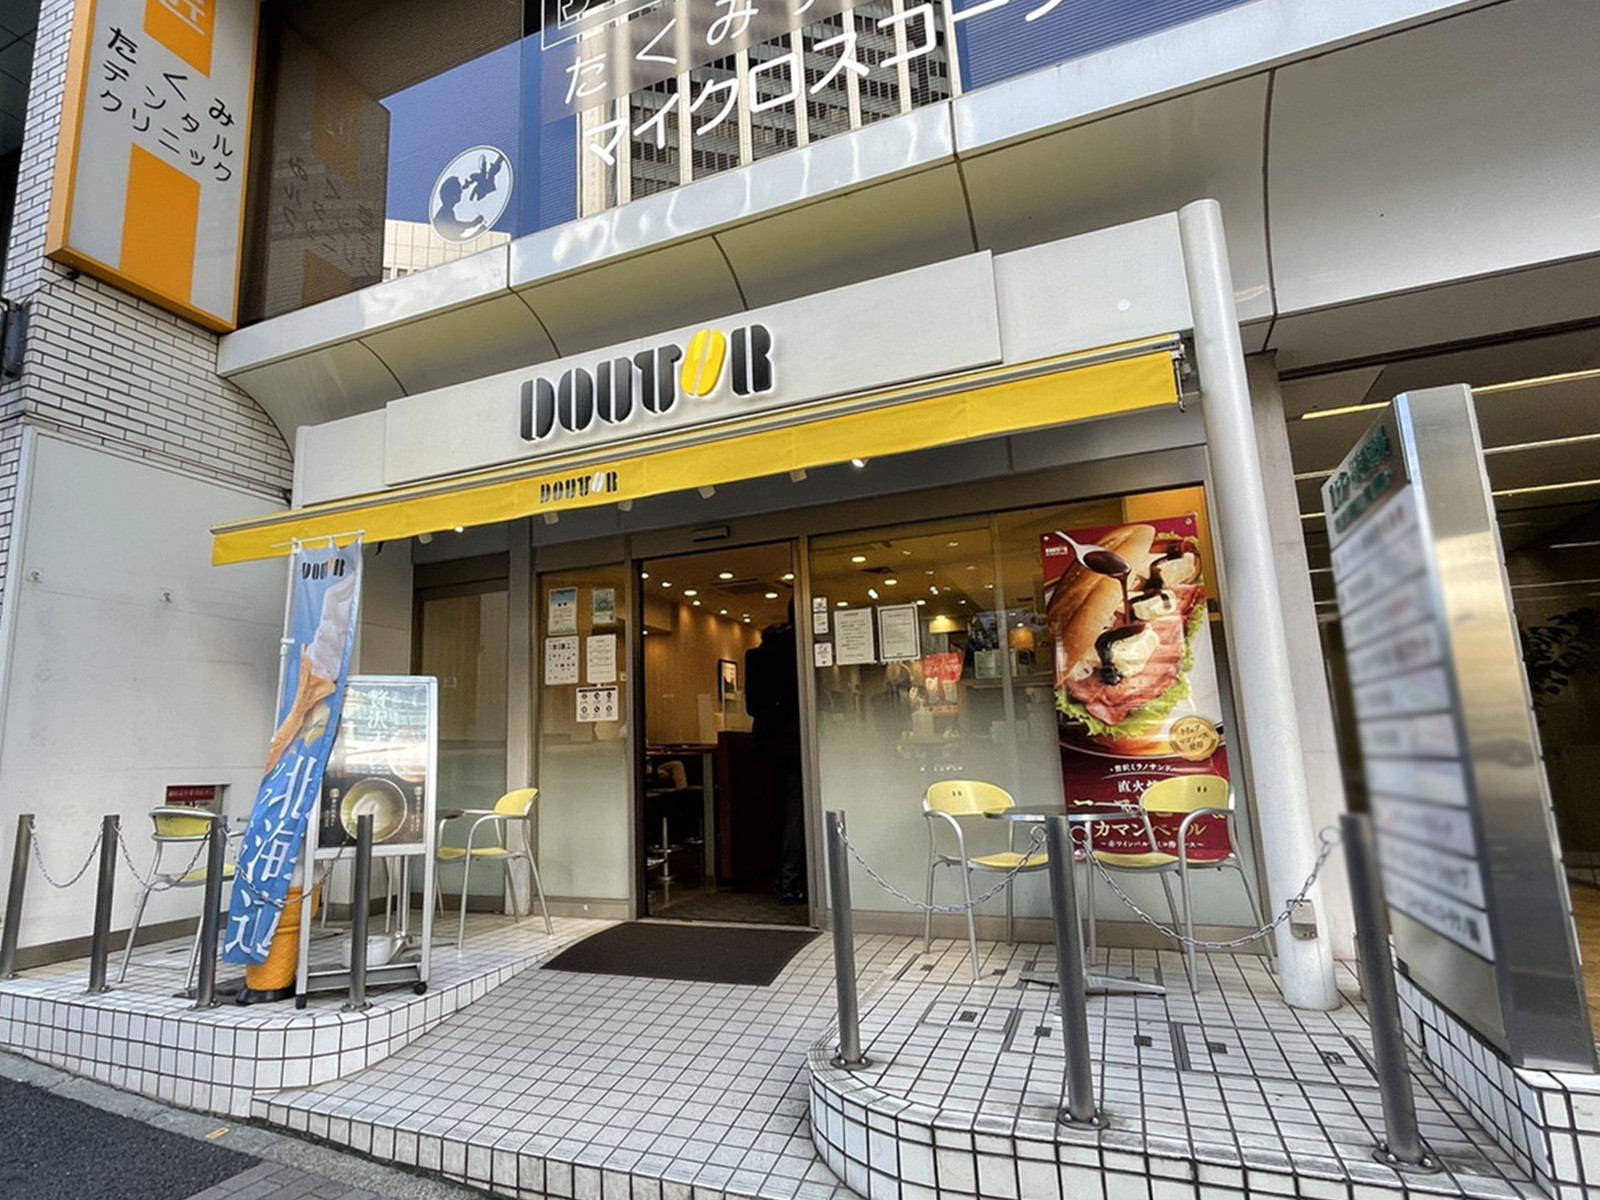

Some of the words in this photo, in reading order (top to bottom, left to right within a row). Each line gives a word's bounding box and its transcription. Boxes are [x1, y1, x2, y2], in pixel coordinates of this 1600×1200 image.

[102, 59, 233, 157] デンタル
[109, 26, 235, 127] たくみ
[583, 0, 1062, 166] マイクロスコー
[100, 90, 232, 182] クリニック
[519, 324, 774, 442] DOUTOR
[539, 471, 618, 503] DOUTOR
